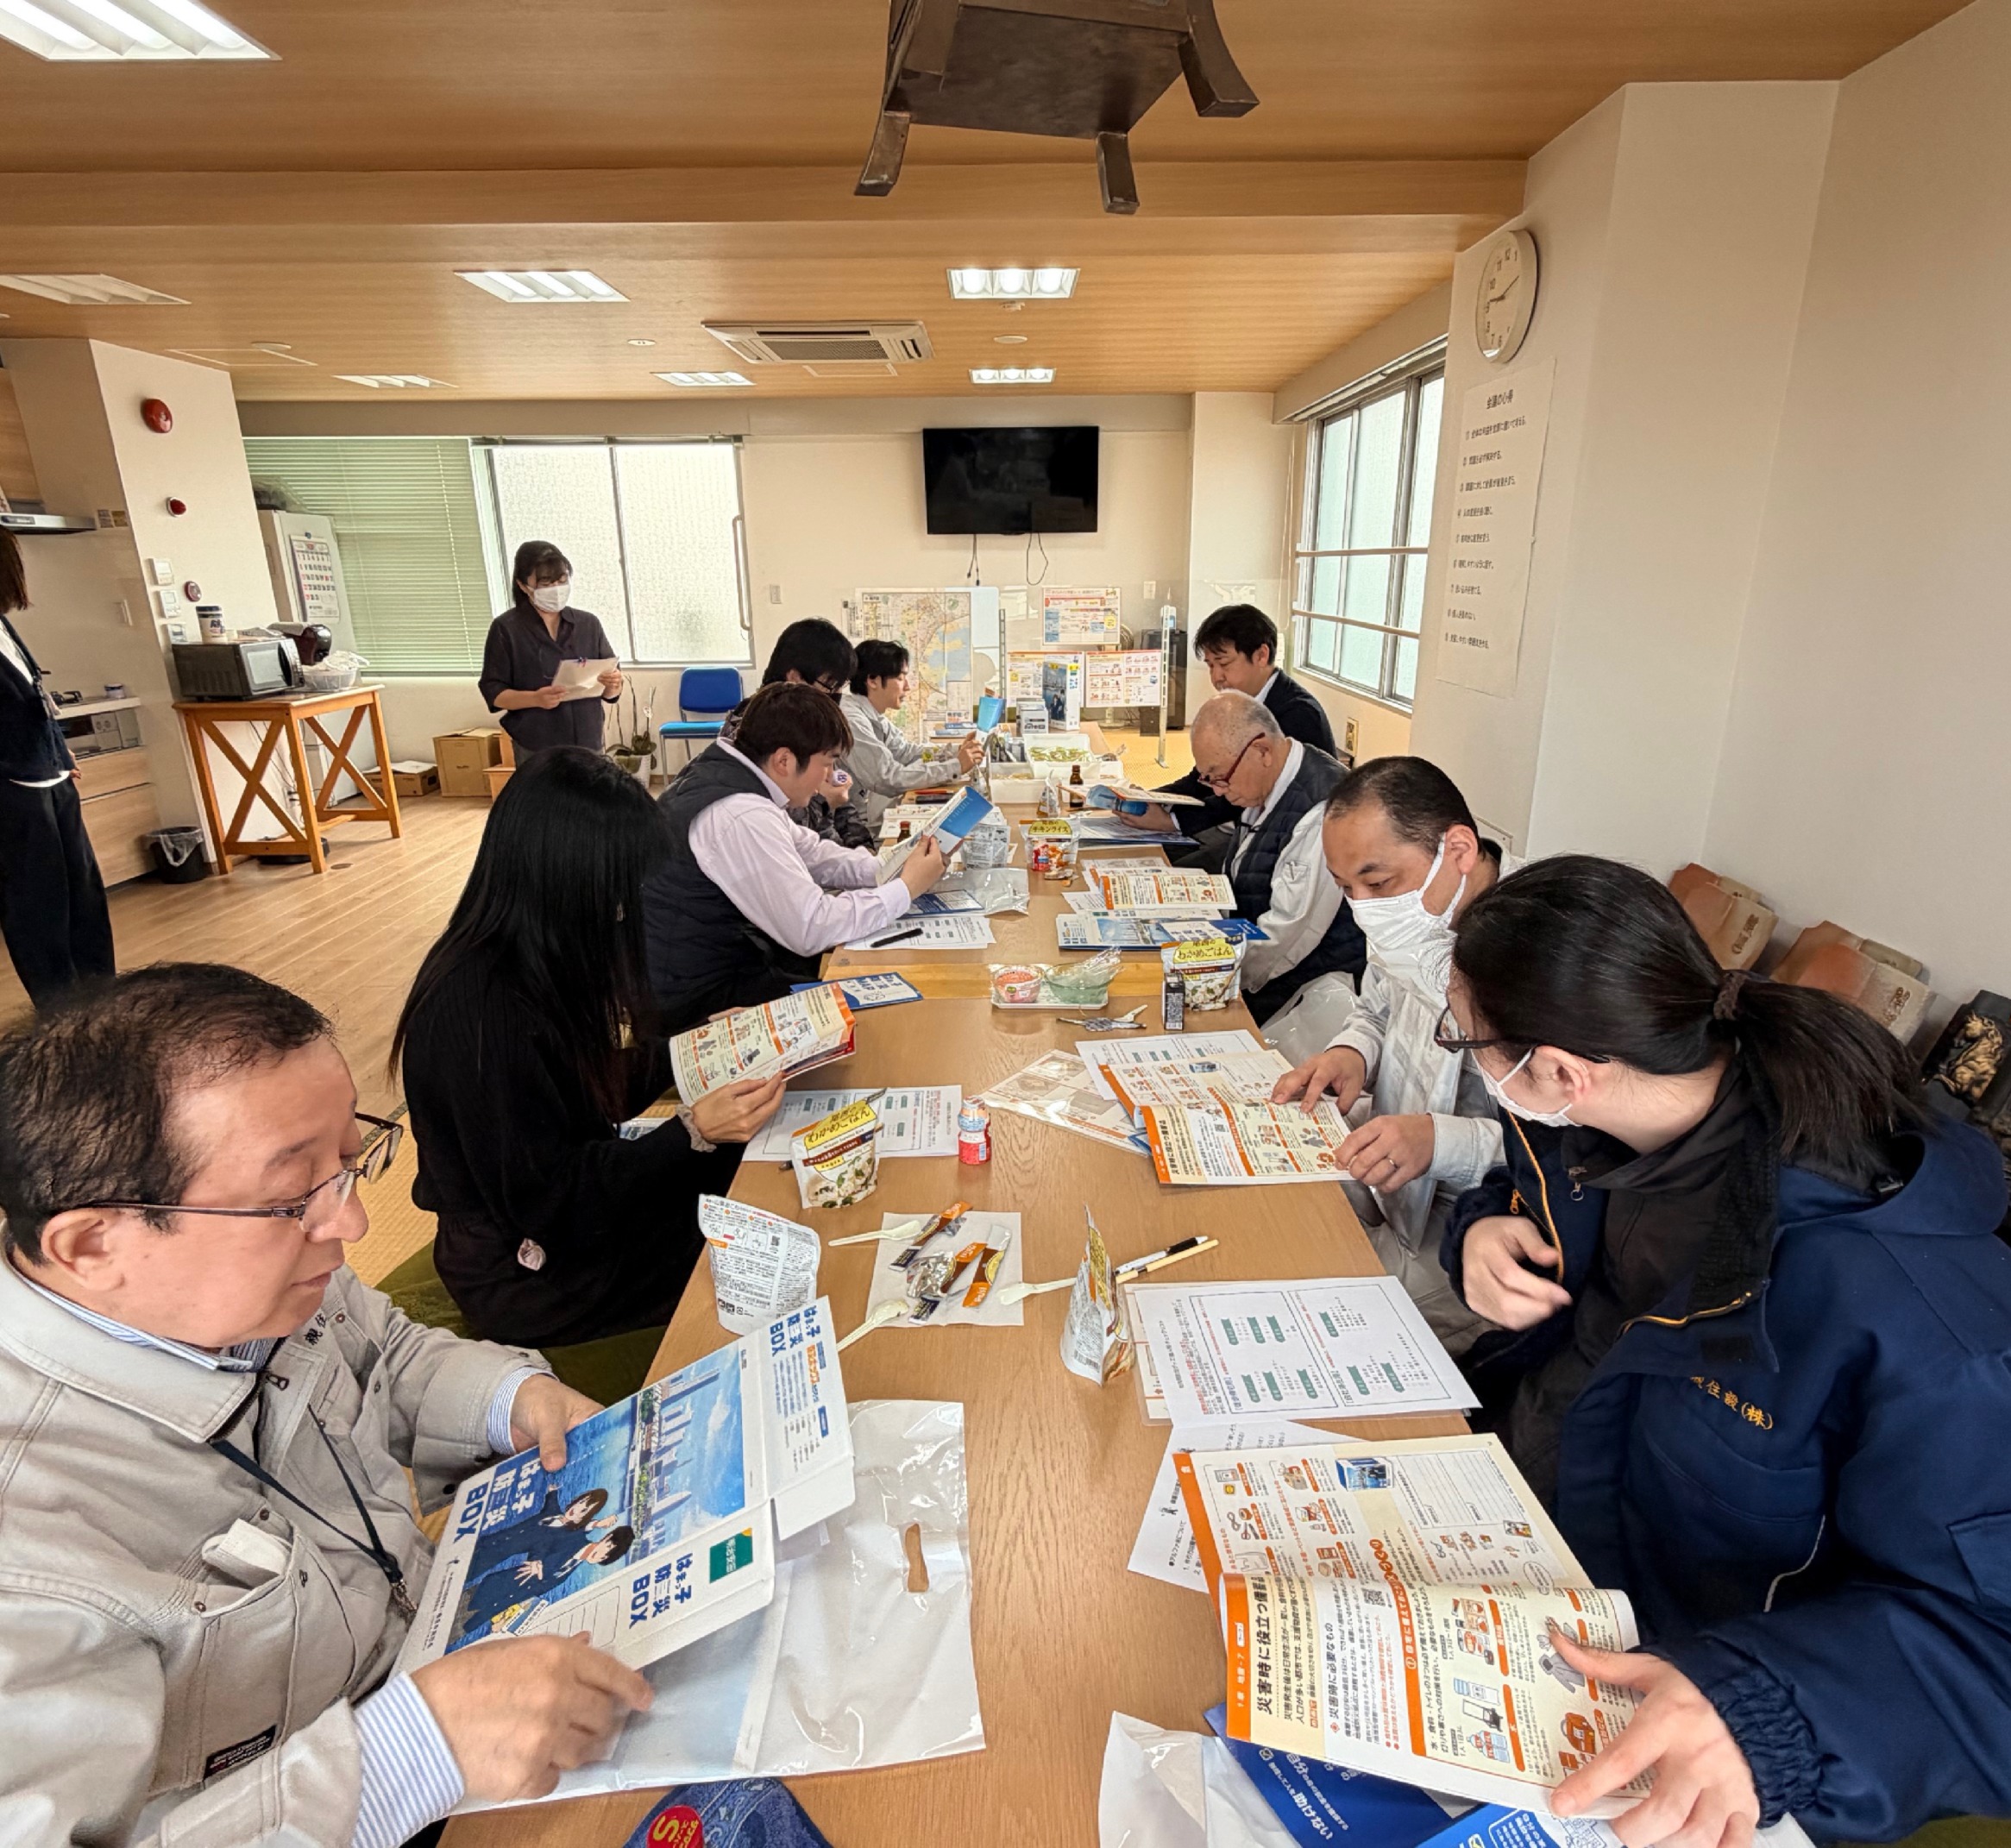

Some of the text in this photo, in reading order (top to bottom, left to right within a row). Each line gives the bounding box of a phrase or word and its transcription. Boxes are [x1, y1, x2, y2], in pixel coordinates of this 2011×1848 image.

[1178, 946, 1232, 959] わかめごはん
[808, 1106, 870, 1143] わかめごはん
[769, 1322, 789, 1357] BOX
[452, 1482, 492, 1543] BOX
[482, 1473, 512, 1529] 防災
[510, 1459, 543, 1519] はまっ子
[629, 1572, 652, 1629] BOX
[653, 1564, 672, 1618] 防災
[674, 1552, 694, 1604] はまっ子
[1250, 1575, 1274, 1716] 災害時に役立つ備蓄品
[1324, 1622, 1339, 1719] 災害時に必要なもの
